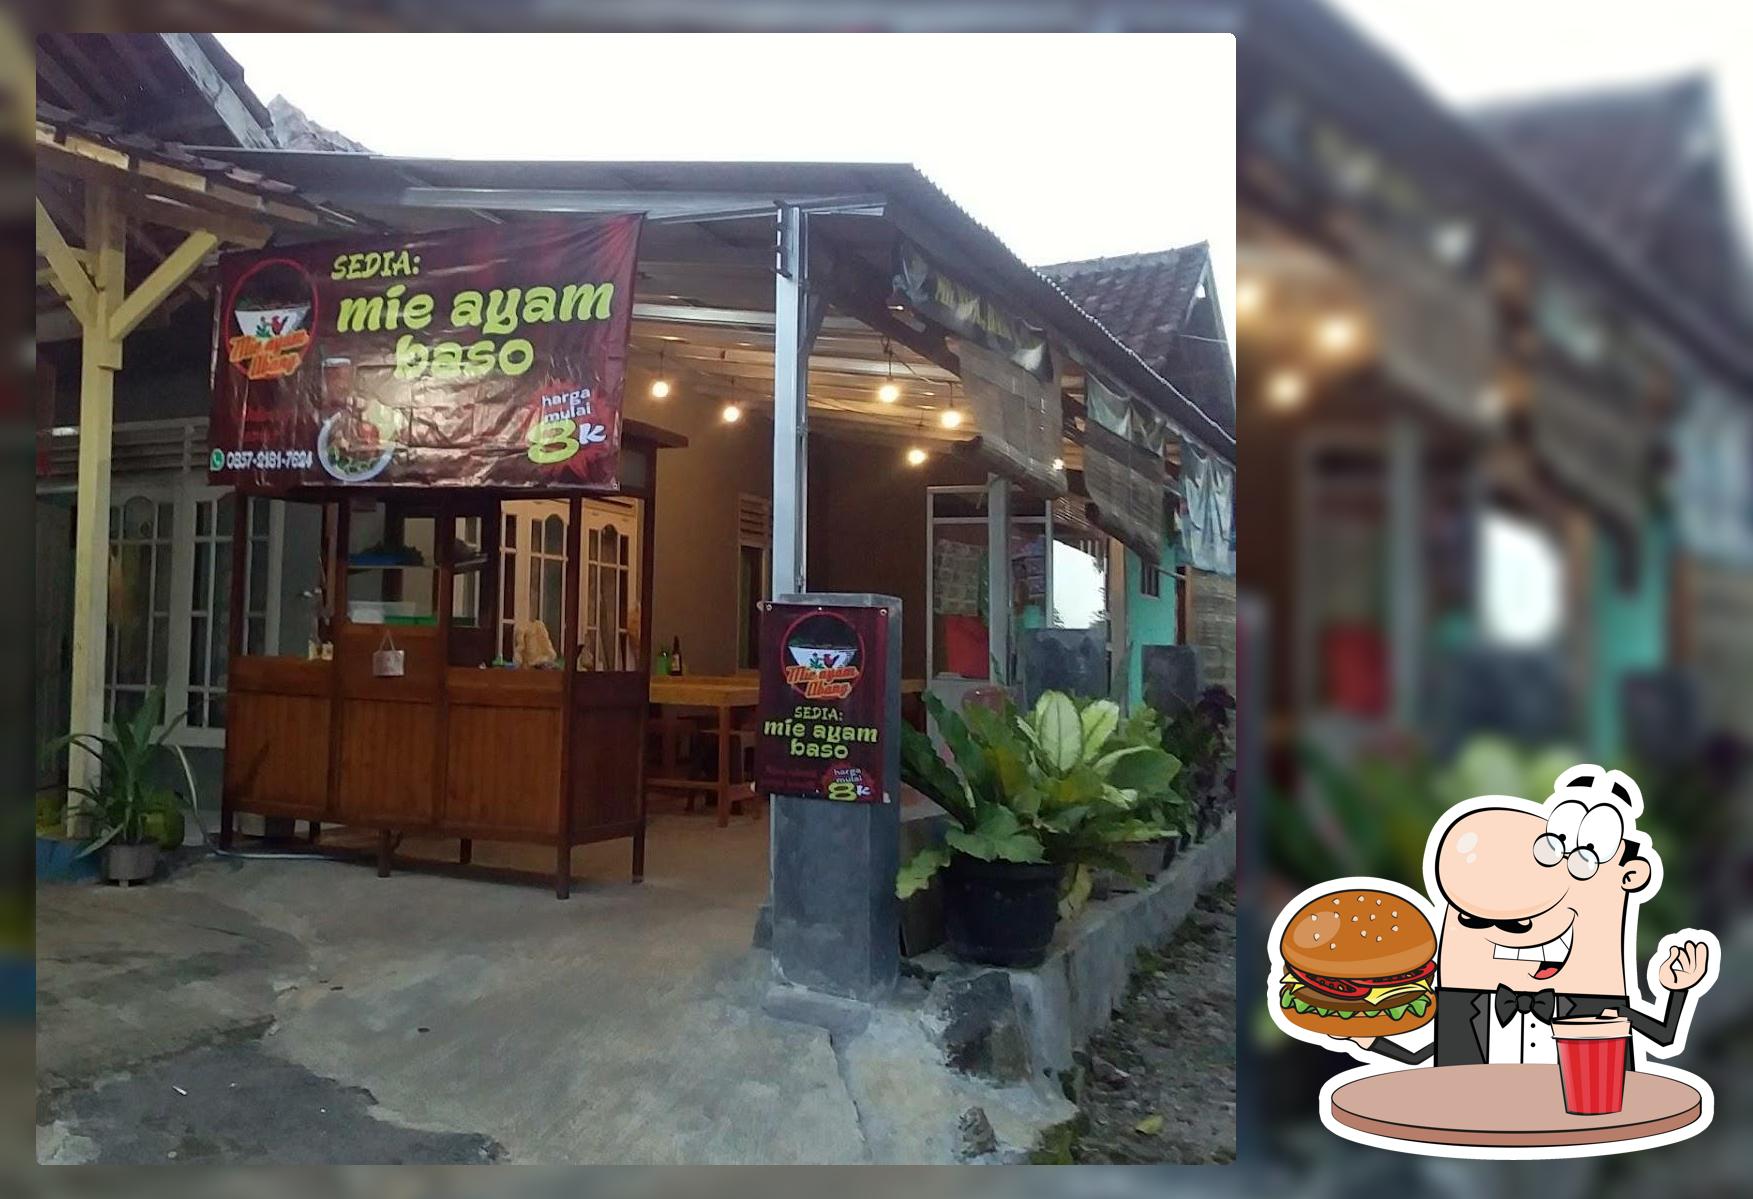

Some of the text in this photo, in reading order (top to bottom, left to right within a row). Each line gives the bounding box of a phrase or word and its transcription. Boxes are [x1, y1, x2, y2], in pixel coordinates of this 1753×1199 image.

[331, 250, 420, 280] SEDIA:
[337, 283, 614, 334] mie ayam
[393, 334, 534, 380] baso
[542, 389, 590, 407] harga
[544, 402, 591, 423] mulai
[794, 706, 843, 721] SEDIA:
[763, 719, 878, 743] mie ayam
[790, 738, 848, 759] baso
